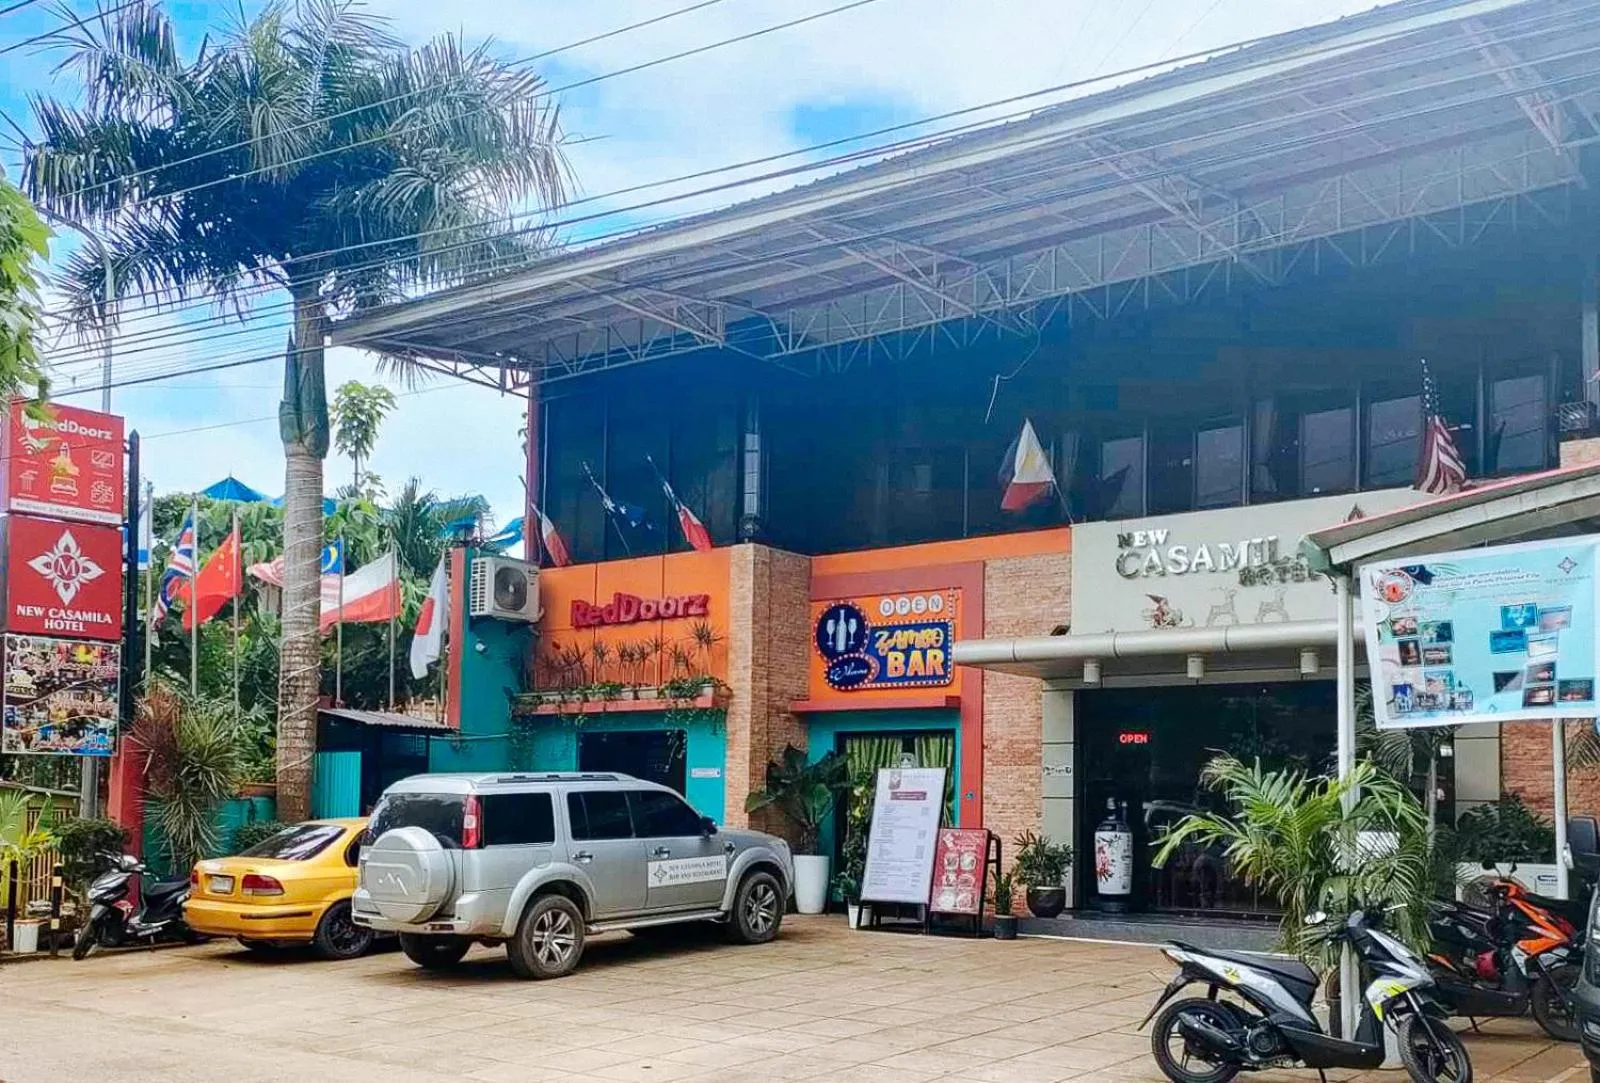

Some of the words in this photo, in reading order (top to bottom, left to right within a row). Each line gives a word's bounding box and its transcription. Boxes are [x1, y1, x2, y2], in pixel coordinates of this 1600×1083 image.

[1116, 528, 1169, 549] NEW
[16, 604, 45, 617] NEW
[48, 607, 112, 624] CASAMILA
[571, 592, 710, 629] RedDoorz
[881, 595, 943, 615] OPEN
[44, 618, 86, 632] HOTEL
[887, 649, 945, 677] BAR
[1119, 733, 1148, 744] OPEN
